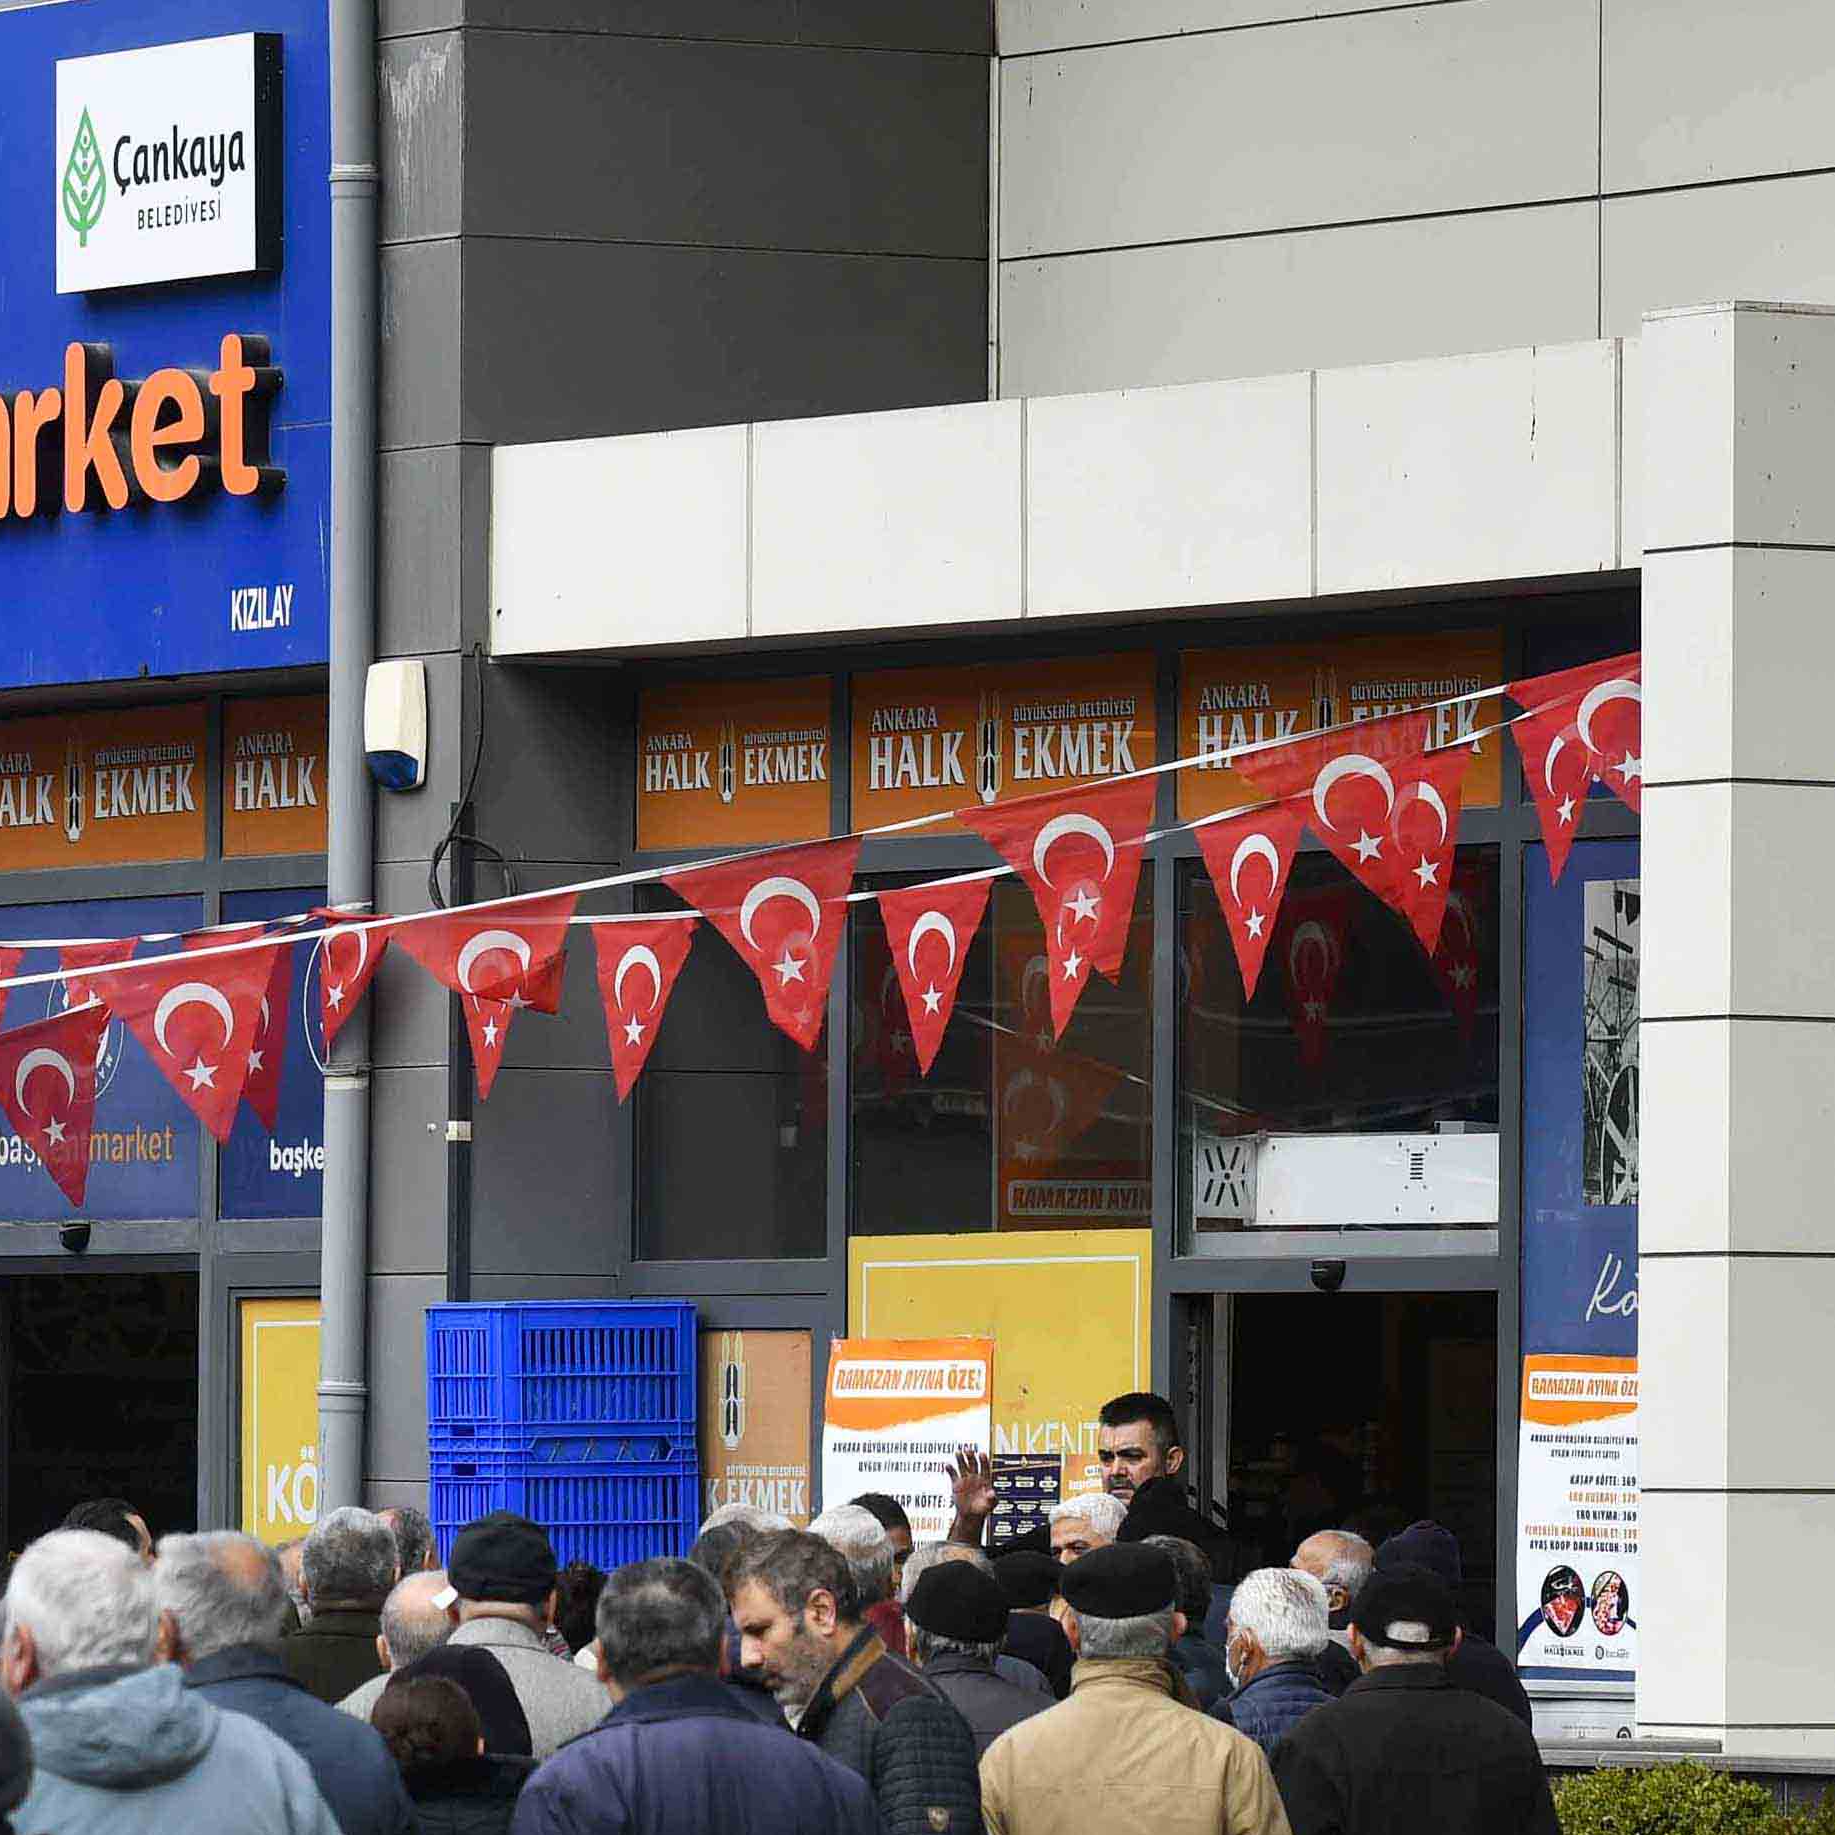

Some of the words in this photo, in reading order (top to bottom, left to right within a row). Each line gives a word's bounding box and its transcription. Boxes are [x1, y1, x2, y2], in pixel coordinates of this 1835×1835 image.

[113, 125, 245, 196] Çankaya
[137, 191, 222, 230] BELEDİYESİ
[230, 585, 294, 633] KIZILAY
[1200, 684, 1271, 710] ANKARA
[870, 706, 938, 732] ANKARA
[236, 733, 294, 756] ANKARA
[646, 735, 694, 751] ANKARA
[868, 731, 966, 790] HALK
[1013, 720, 1136, 779] EKMEK
[234, 757, 318, 811] HALK
[645, 751, 711, 793] HALK
[743, 745, 828, 785] EKMEK
[93, 763, 196, 819] EKMEK
[89, 1122, 176, 1165] market
[836, 1368, 903, 1391] RAMAZAN
[902, 1368, 944, 1391] AYINA
